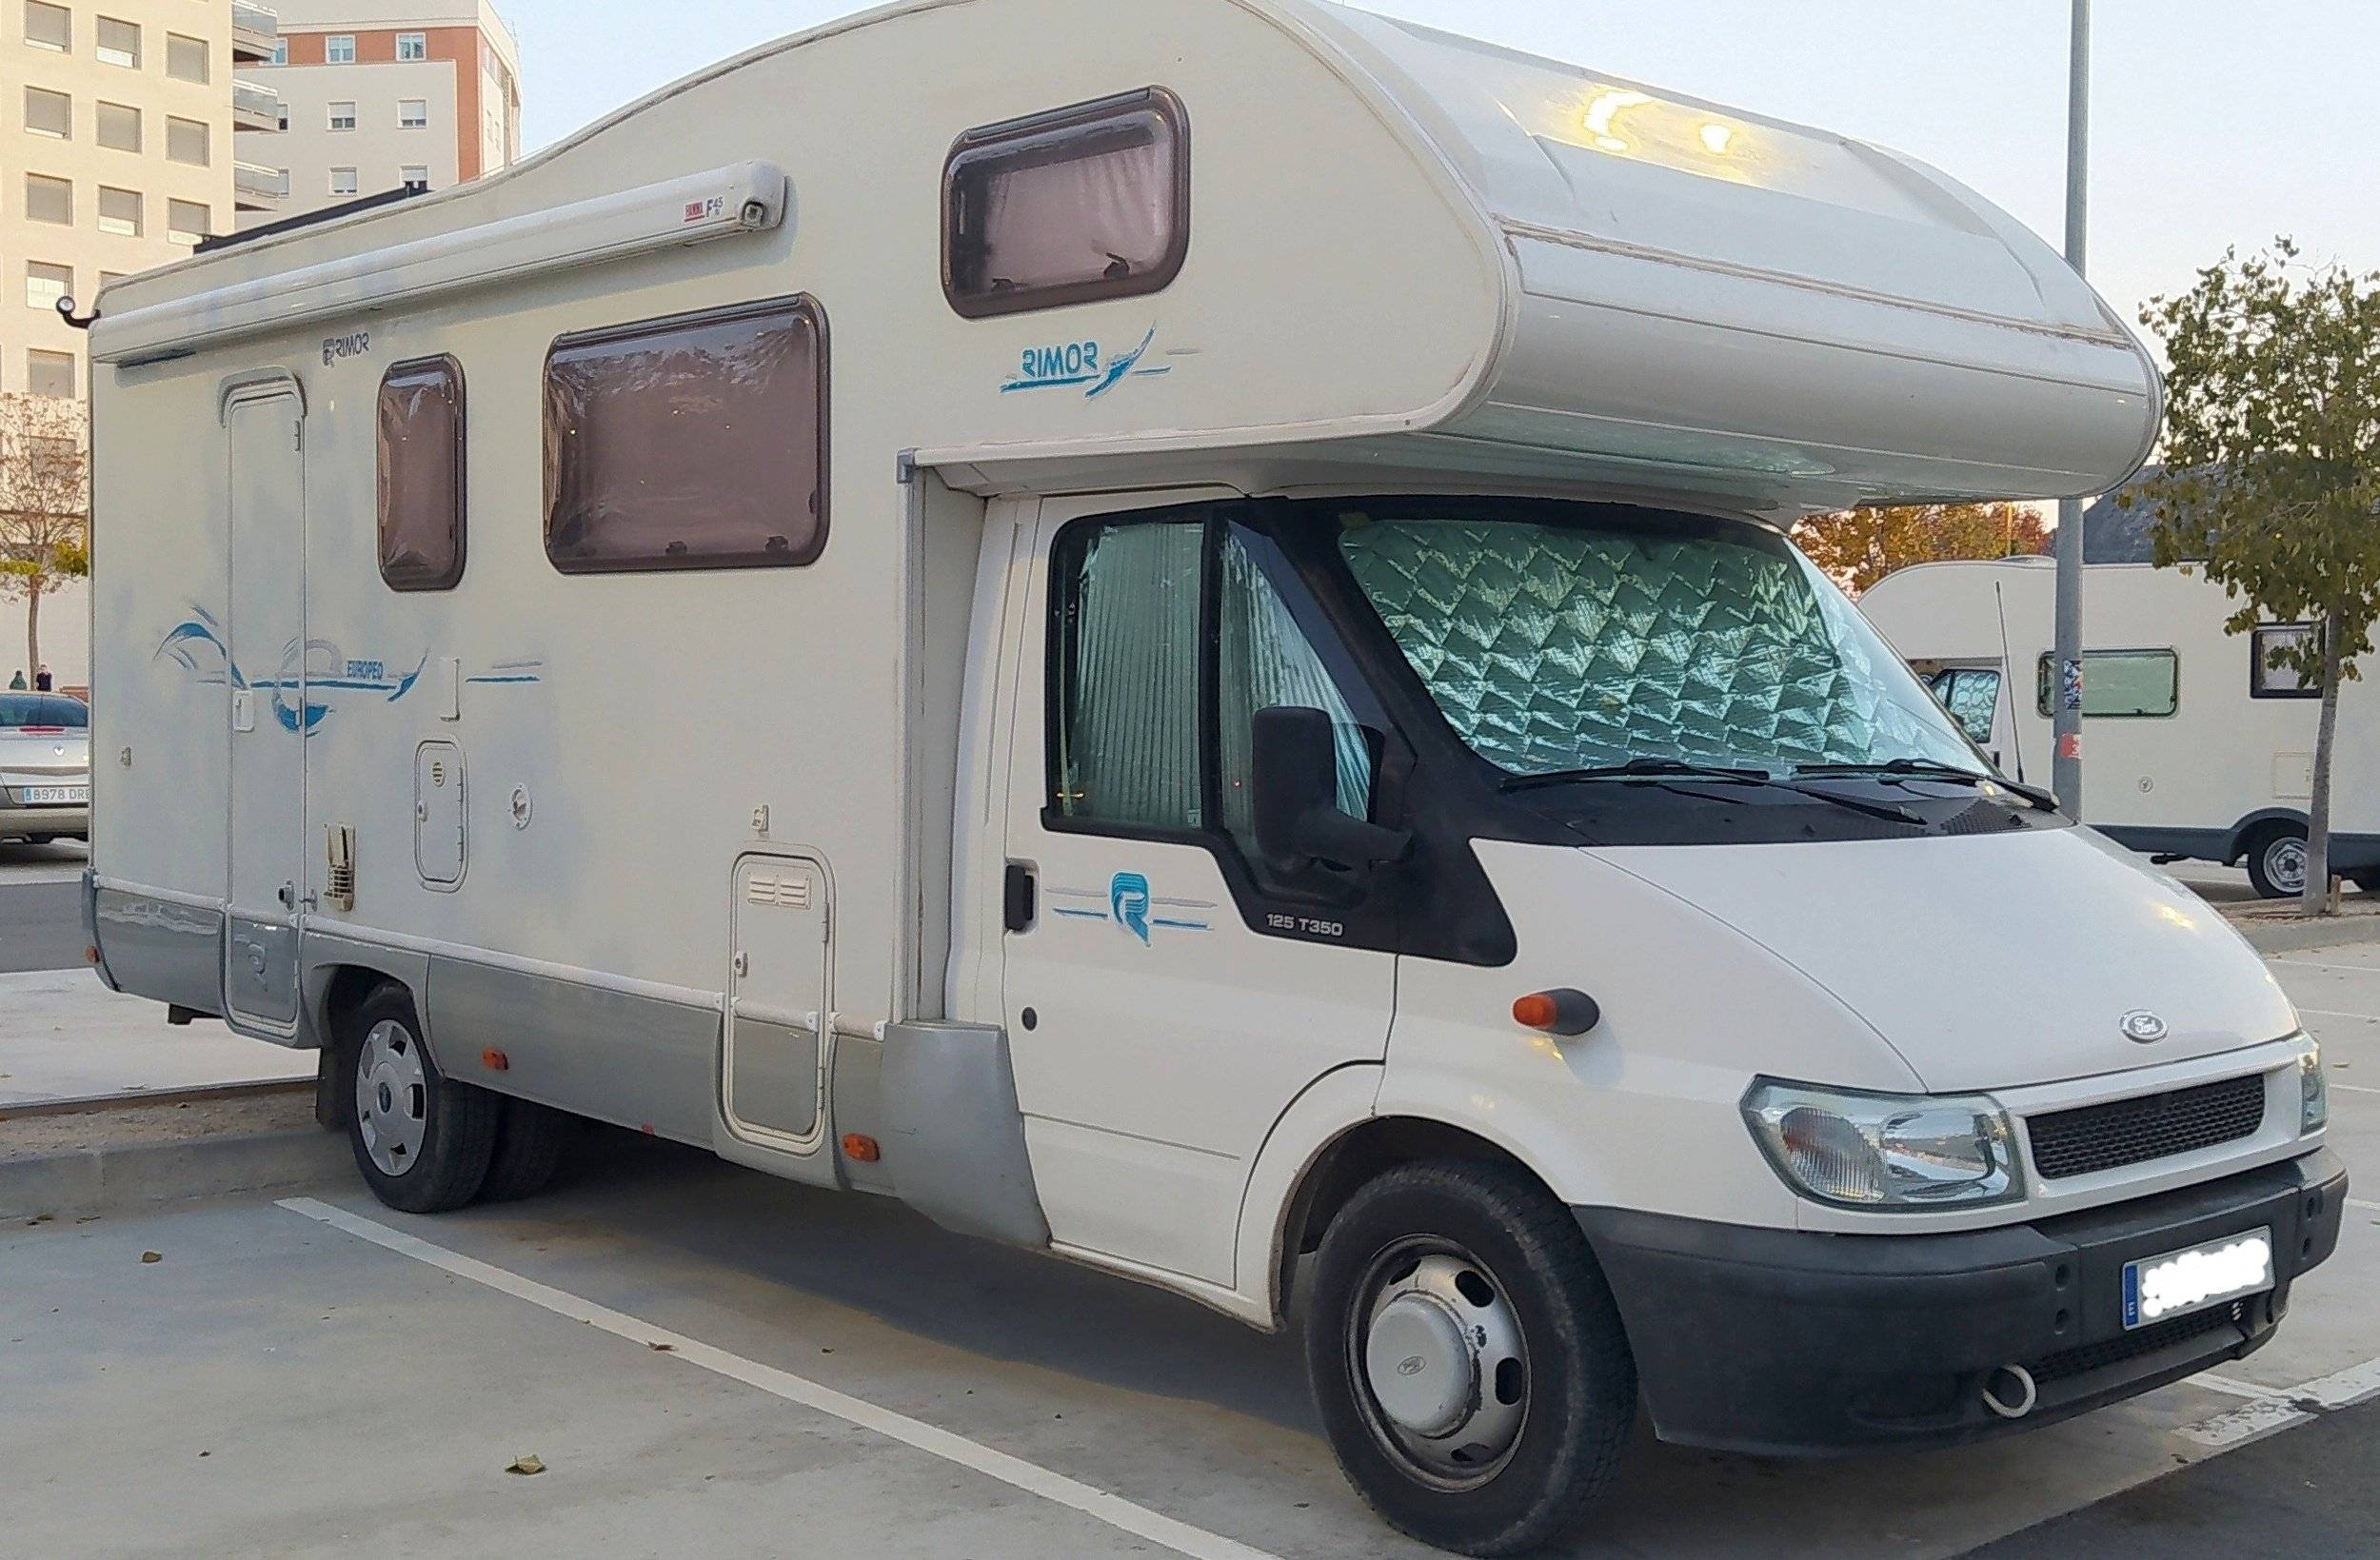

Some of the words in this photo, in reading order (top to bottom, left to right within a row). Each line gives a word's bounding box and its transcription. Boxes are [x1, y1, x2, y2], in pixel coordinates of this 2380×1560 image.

[1022, 342, 1098, 377] RIMOR
[33, 789, 65, 800] 8978
[1267, 914, 1294, 929] 125
[1299, 918, 1342, 936] T350
